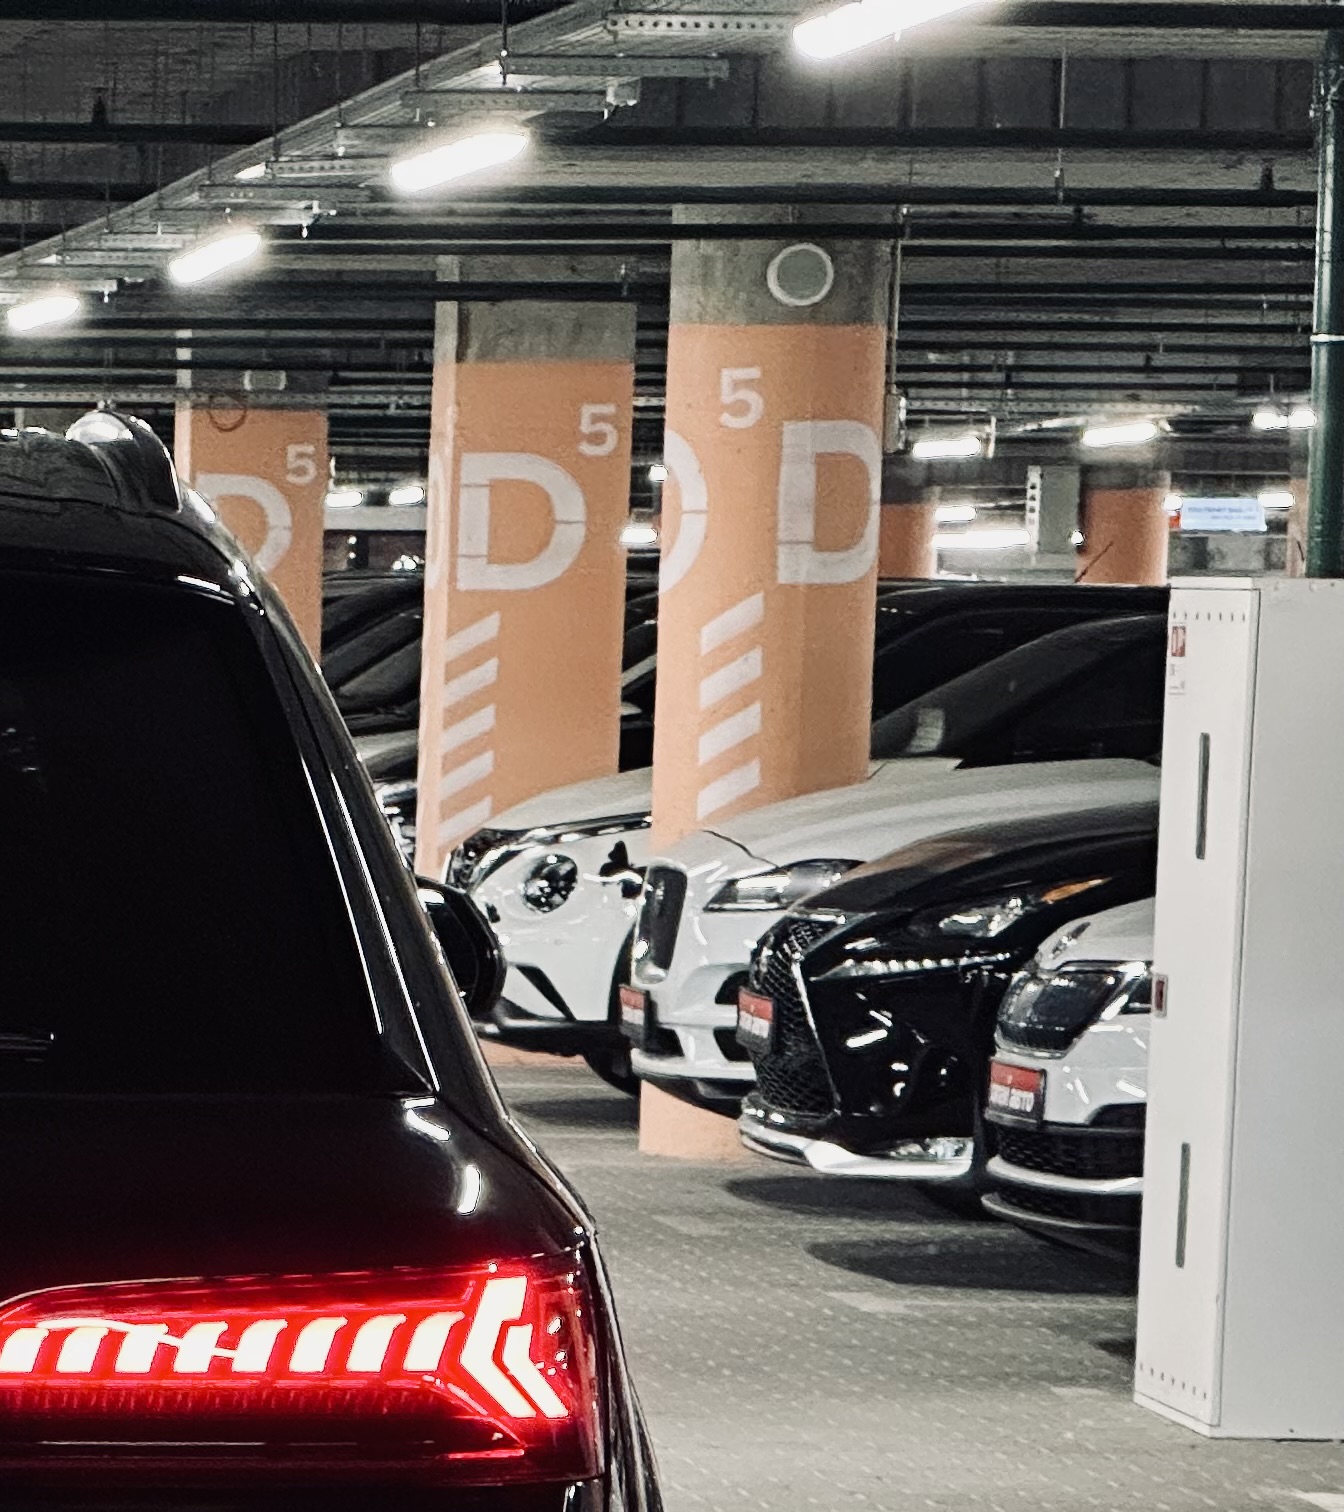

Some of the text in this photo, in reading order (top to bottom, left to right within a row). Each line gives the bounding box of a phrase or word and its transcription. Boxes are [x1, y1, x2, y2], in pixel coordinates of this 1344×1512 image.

[719, 367, 763, 429] 5
[577, 403, 619, 457] 5
[286, 443, 318, 485] 5
[457, 452, 588, 591] D
[776, 419, 881, 585] D
